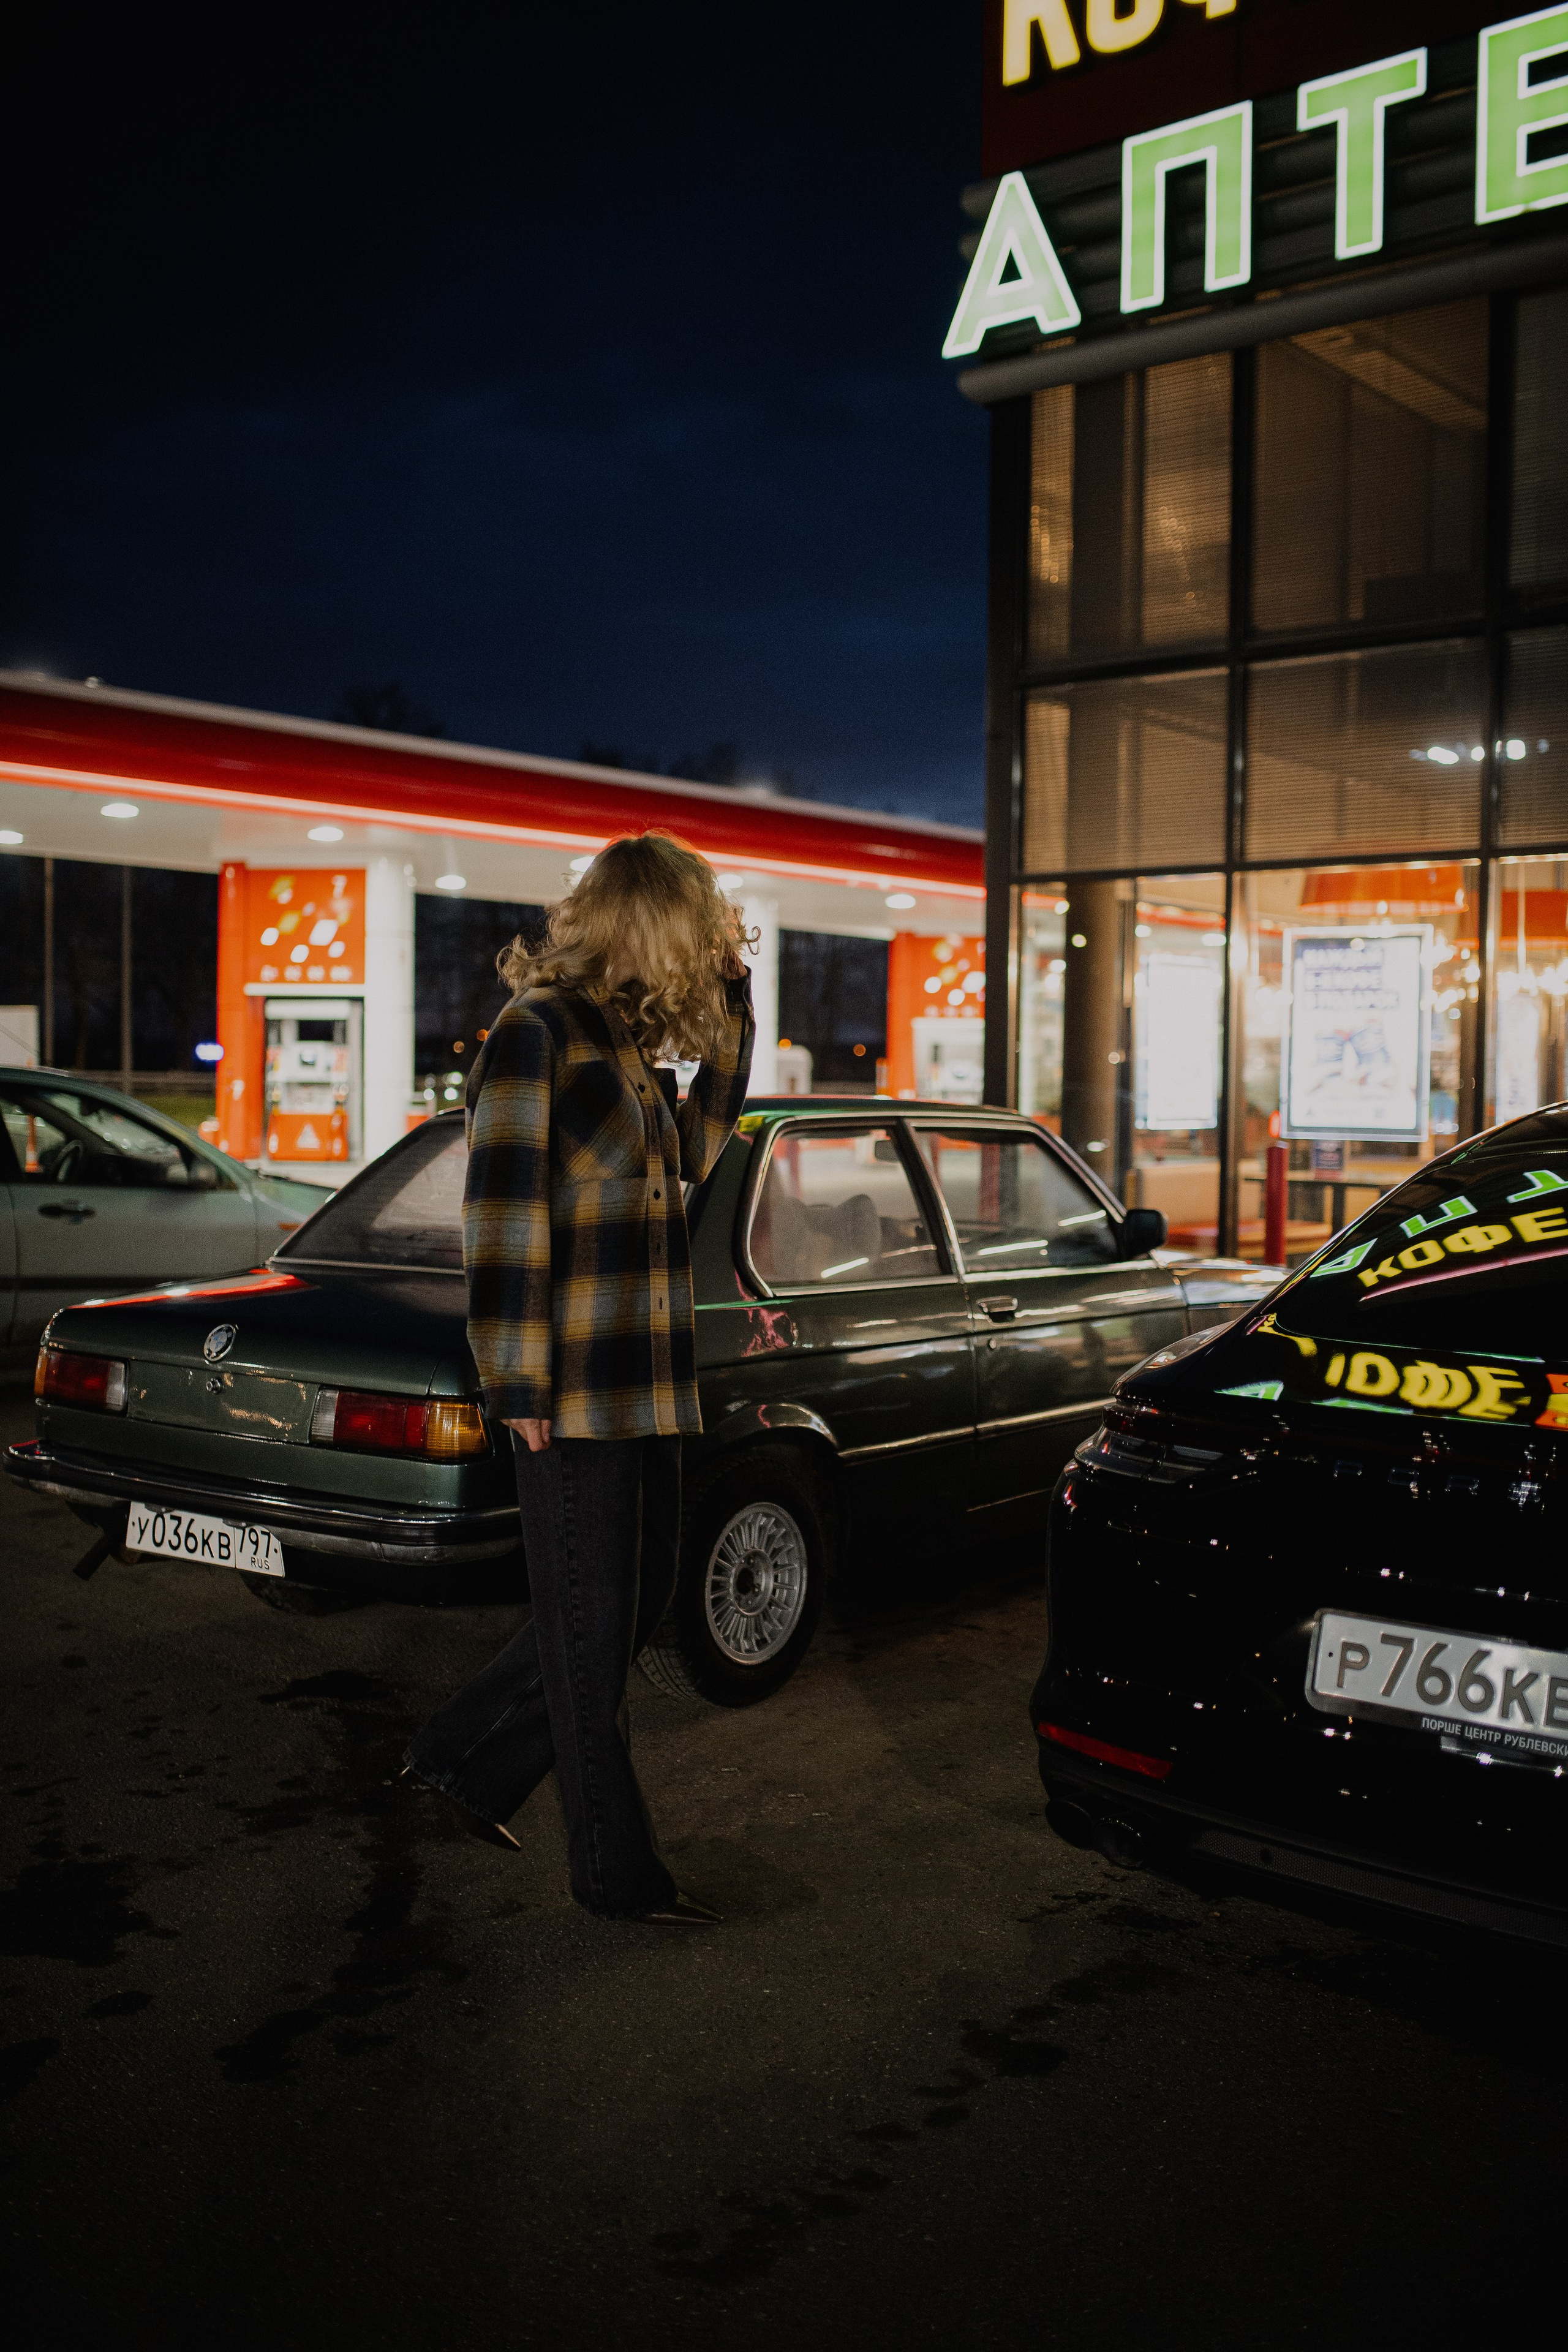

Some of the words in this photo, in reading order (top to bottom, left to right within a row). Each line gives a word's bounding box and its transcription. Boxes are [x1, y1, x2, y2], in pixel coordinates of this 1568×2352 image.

[941, 2, 1568, 359] АПТЕ
[251, 1556, 270, 1570] RUS
[1421, 1717, 1462, 1735] ПОРШЕ
[1464, 1725, 1502, 1743] ЦЕНТР
